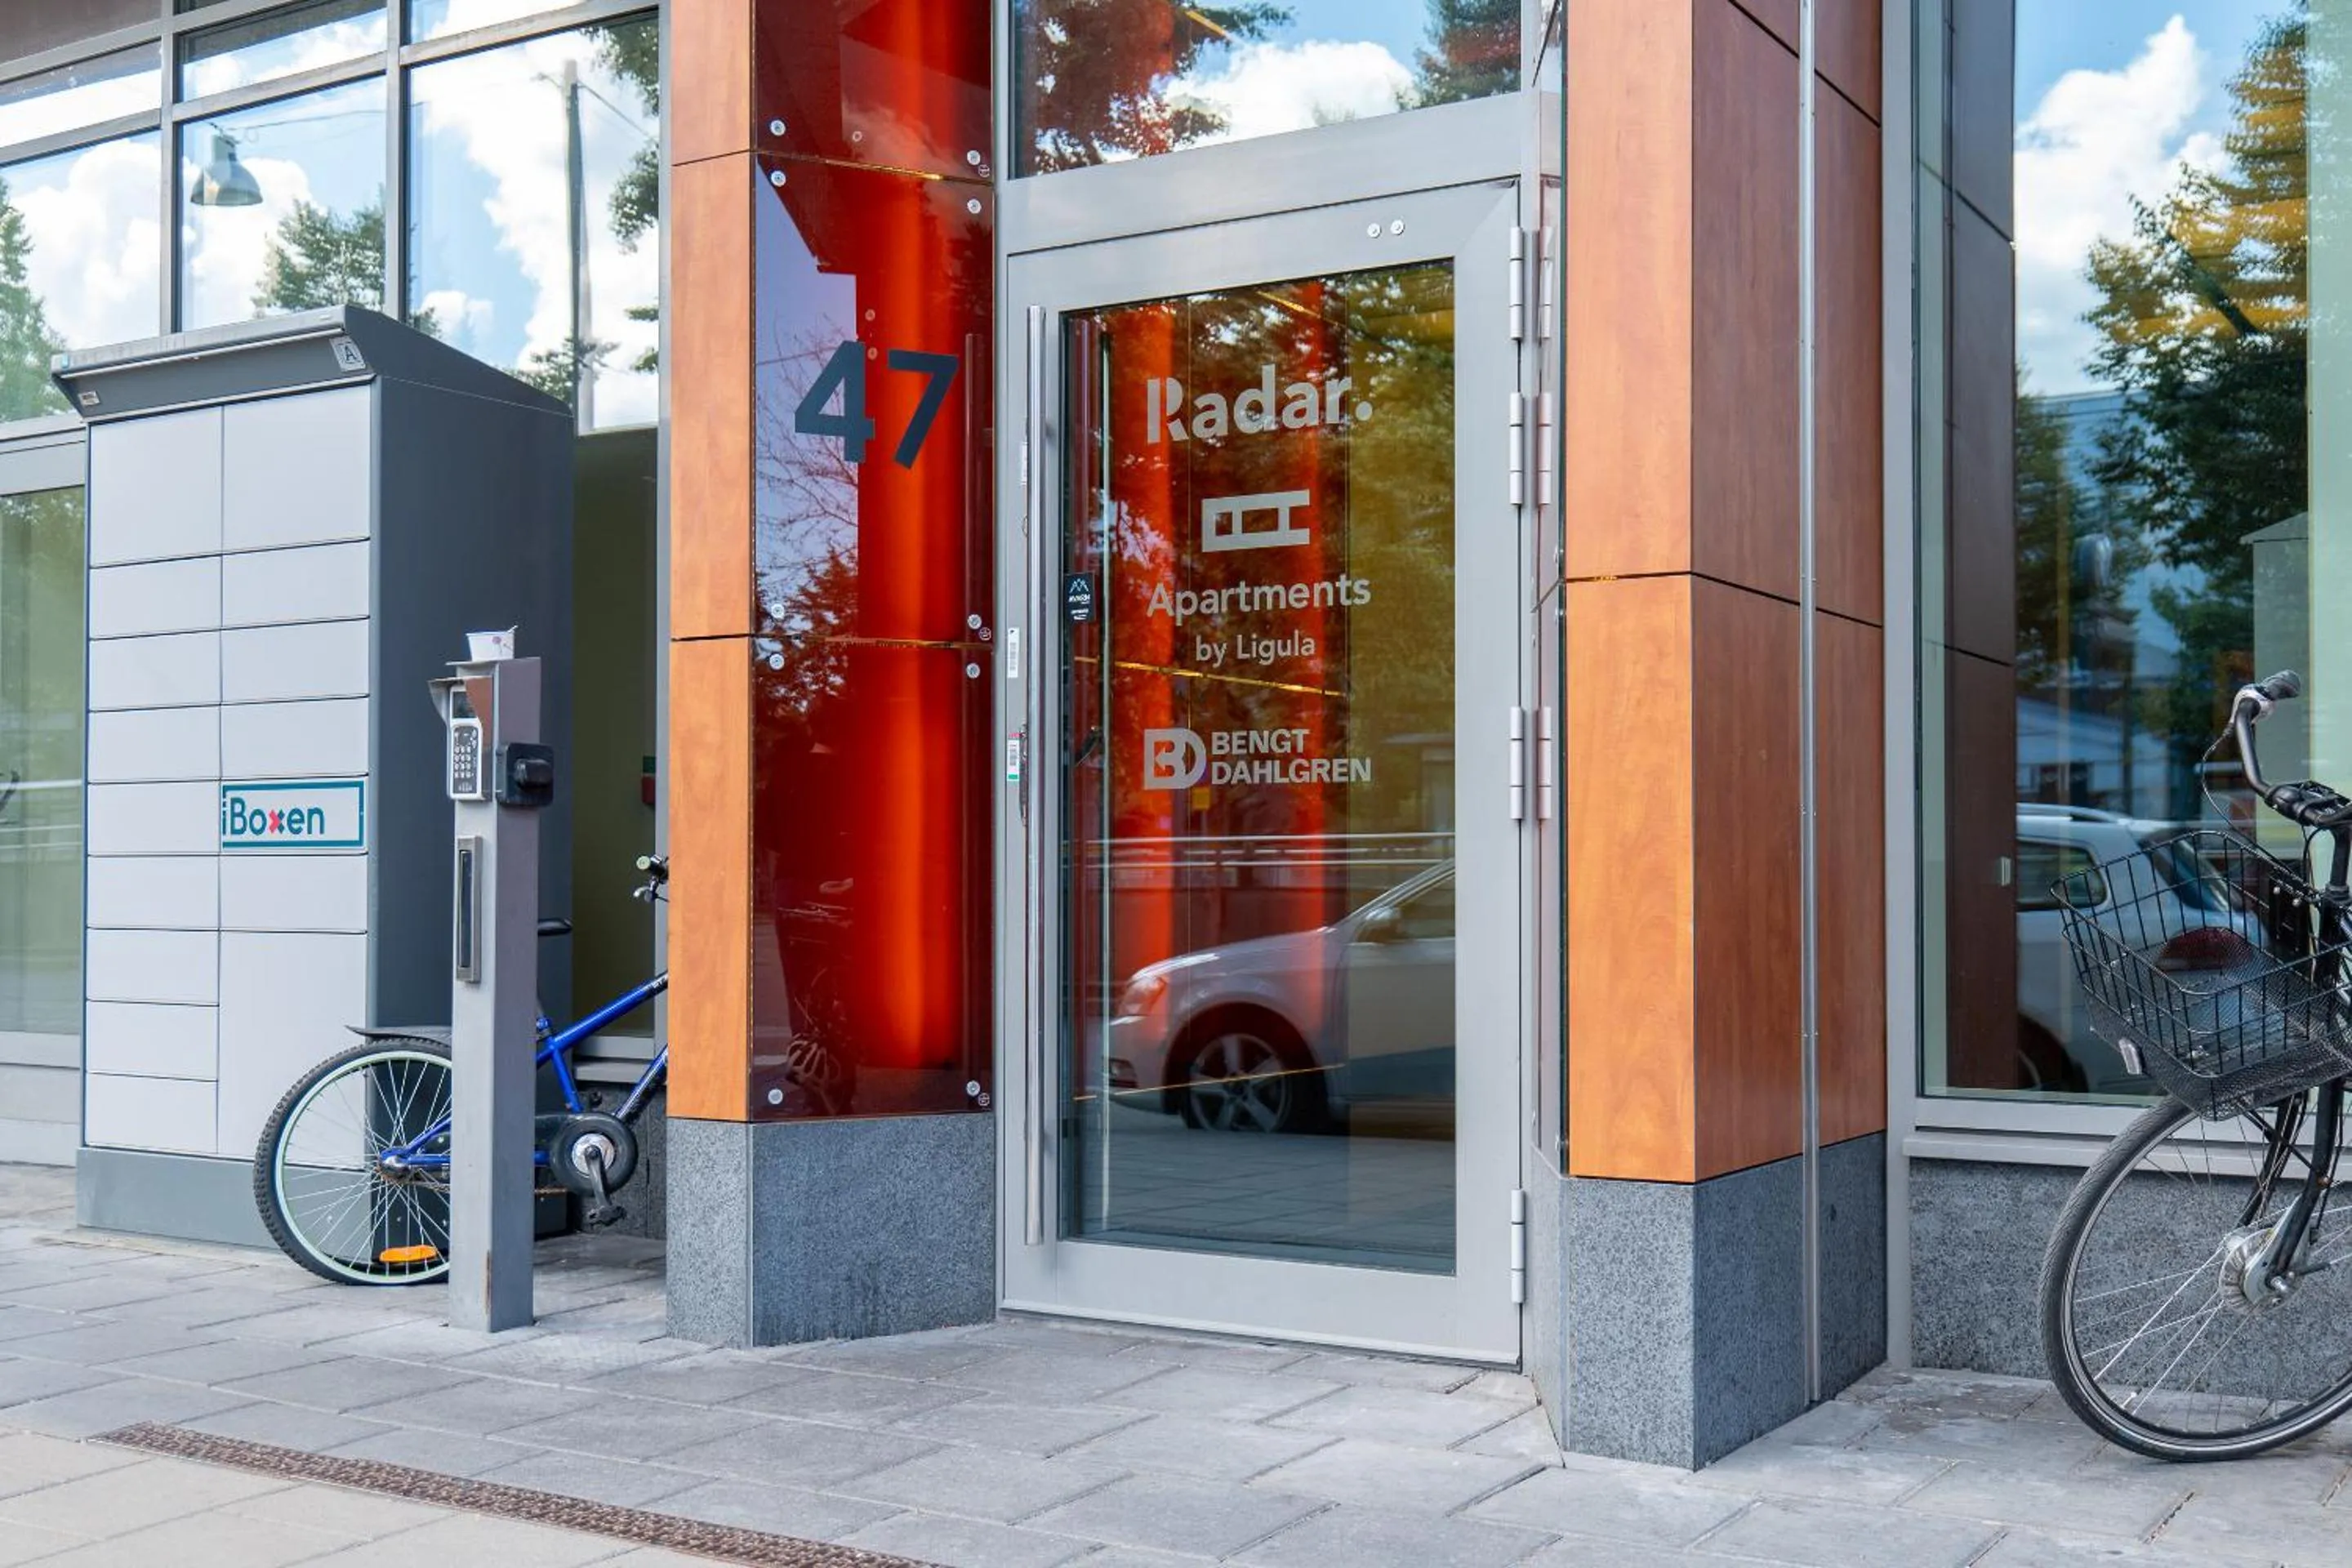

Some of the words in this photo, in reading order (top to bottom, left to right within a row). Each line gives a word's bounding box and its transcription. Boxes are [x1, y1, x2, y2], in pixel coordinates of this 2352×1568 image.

[795, 340, 960, 470] 47
[1147, 363, 1373, 443] Radar.
[1147, 573, 1372, 626] Apartments
[1196, 635, 1227, 668] by
[1236, 629, 1316, 666] Ligula
[1211, 728, 1310, 755] BENGT
[1211, 757, 1372, 785] DAHLGREN
[222, 796, 325, 835] iBoxen
